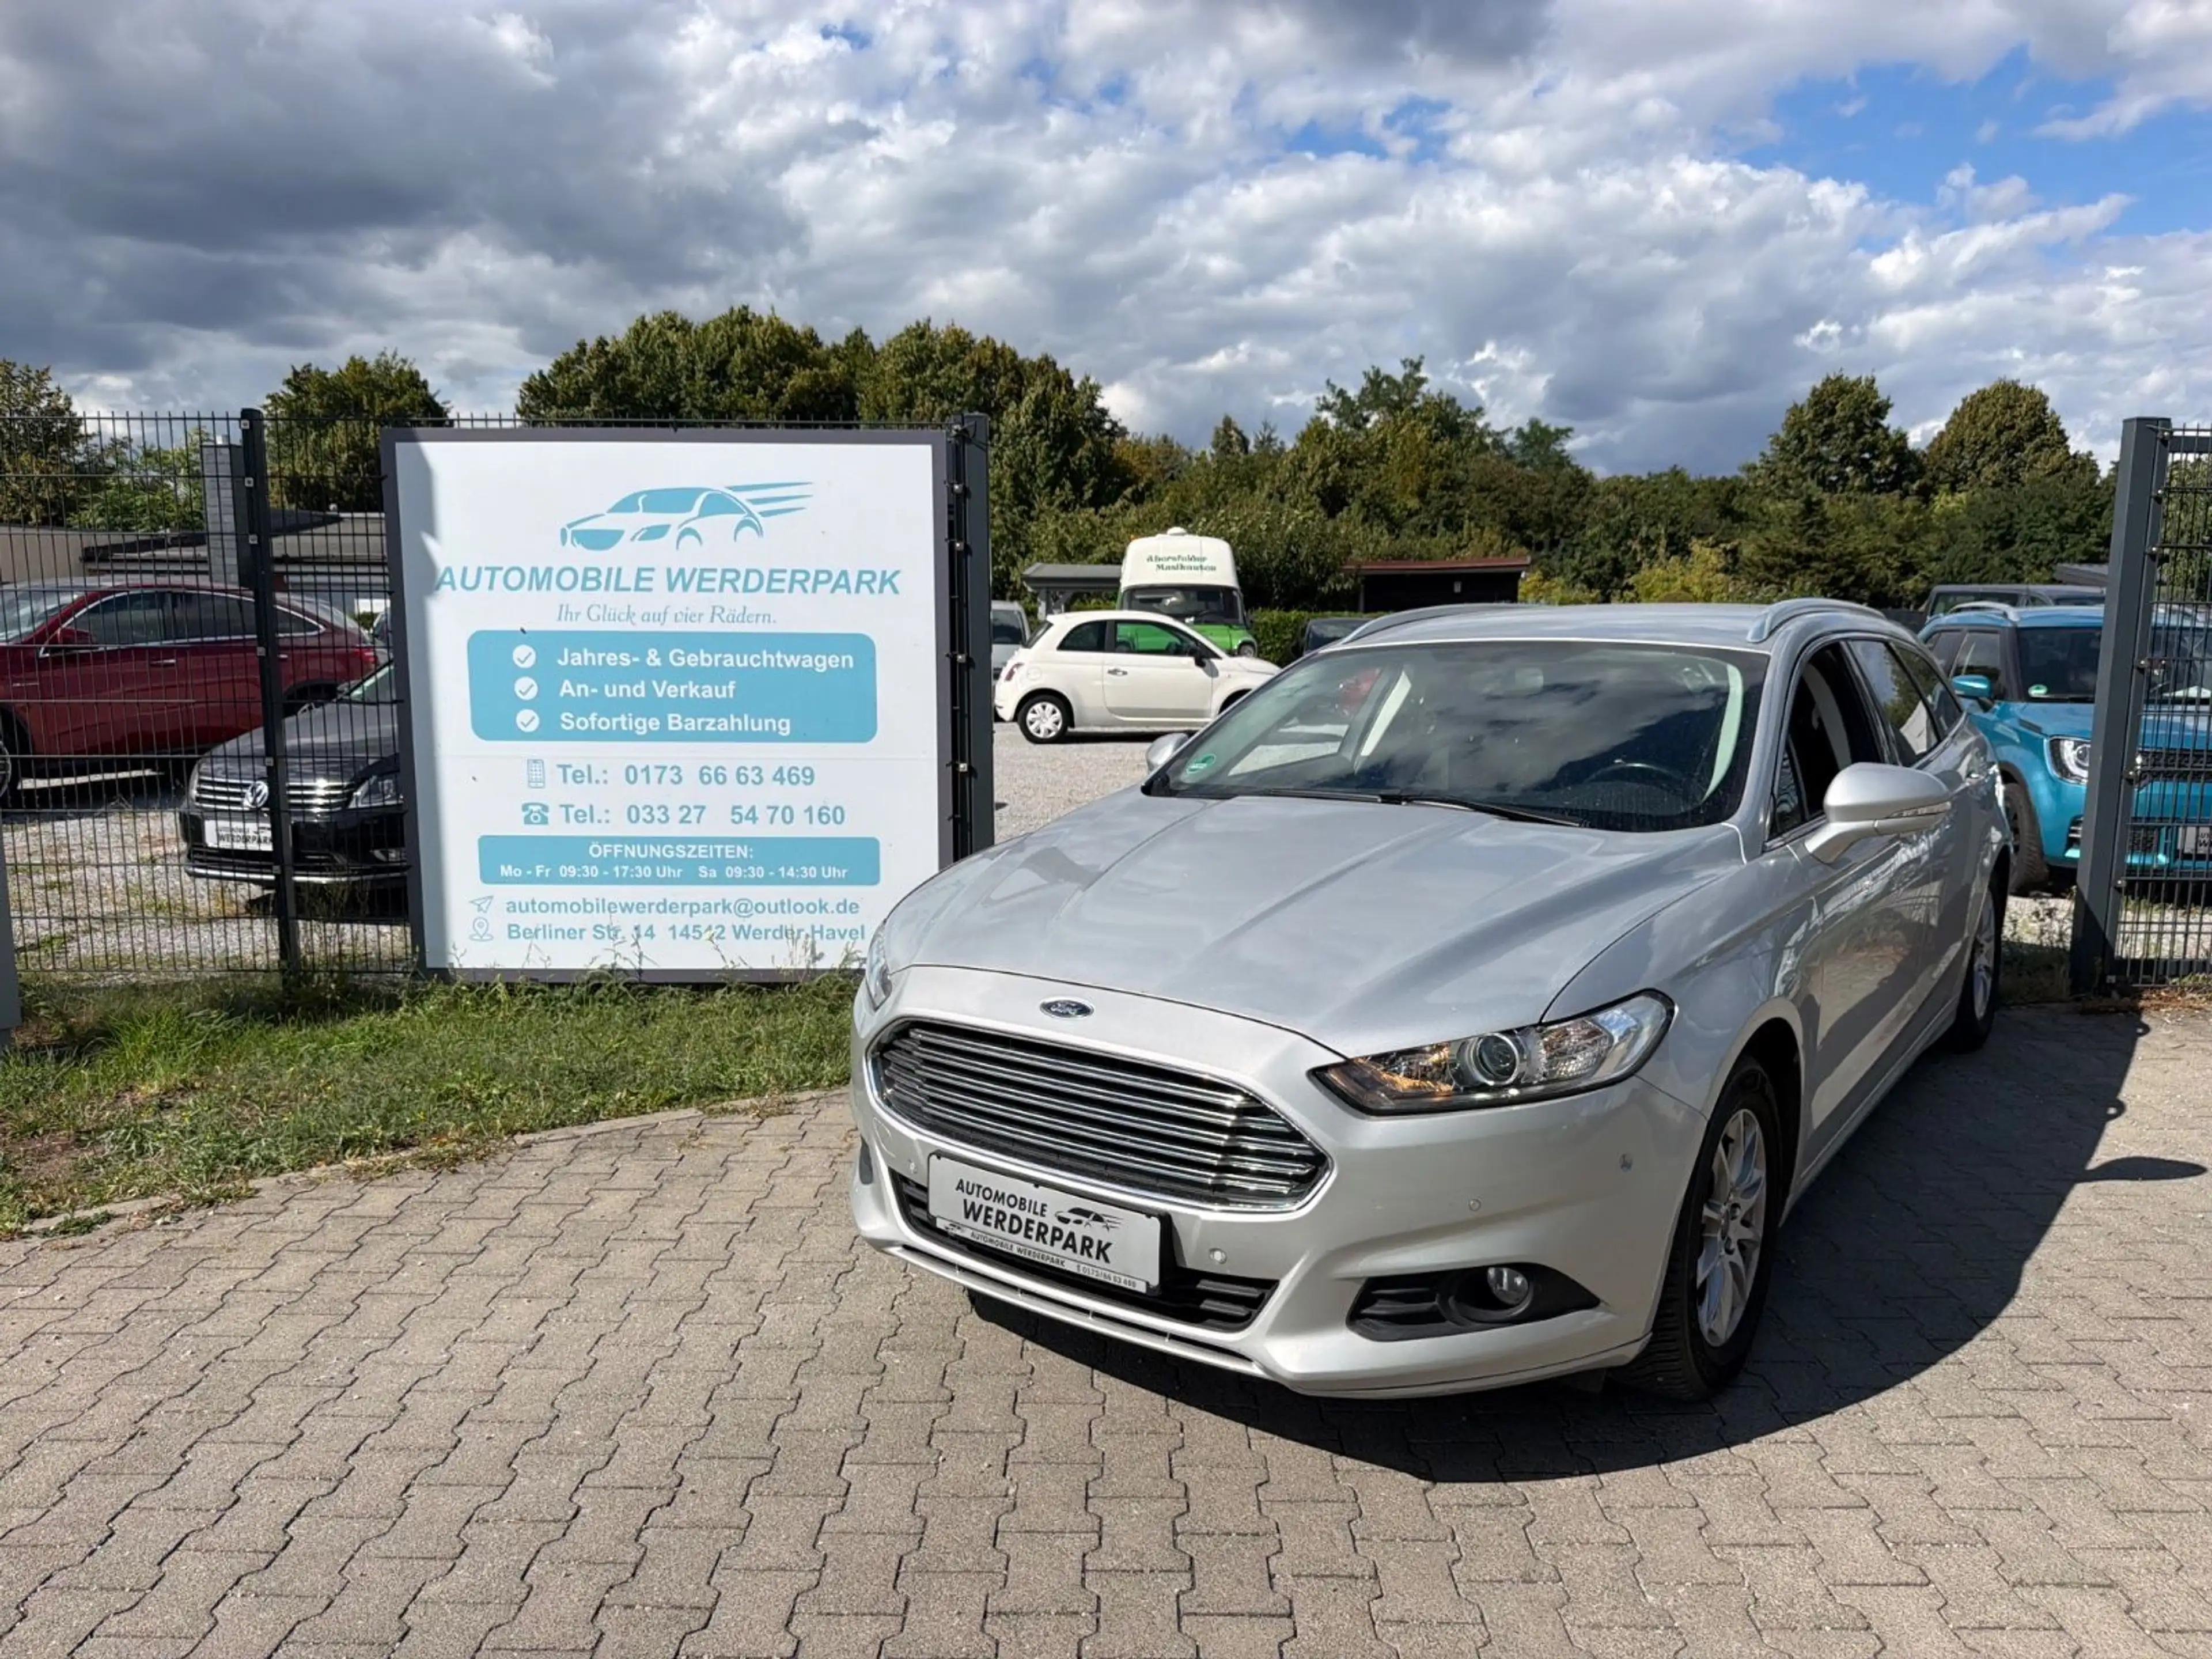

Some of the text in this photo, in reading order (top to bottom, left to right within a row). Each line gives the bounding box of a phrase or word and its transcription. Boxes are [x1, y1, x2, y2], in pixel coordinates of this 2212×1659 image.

[435, 566, 901, 595] AUTOMOBILE WERDERPARK
[556, 603, 777, 626] Ihr Glück auf vier Rädern.
[557, 647, 854, 672] Jahres- & Gebrauchtwagen
[559, 679, 736, 699] An- und Verkauf
[560, 712, 791, 736] Sofortige Barzahlung
[556, 764, 815, 786] Tel.: 0173 66 63 469
[559, 804, 845, 825] Tel.: 033 27 54 70 160
[589, 842, 753, 858] ÖFFNUNGSZEITEN:
[500, 865, 522, 877] Mo
[535, 865, 551, 877] Fr
[559, 865, 599, 877] 09:30
[613, 865, 652, 878] 17:30
[656, 866, 683, 878] Uhr
[698, 865, 717, 878] Sa
[725, 866, 764, 878] 09:30
[778, 866, 817, 878] 14:30
[821, 866, 847, 878] Uhr
[506, 897, 860, 919] automobilewerderpark@outlook.de
[507, 923, 586, 940] Berliner
[593, 923, 626, 940] Str.
[633, 924, 656, 940] 14
[732, 924, 805, 940] Werder
[811, 924, 865, 940] Havel
[955, 1178, 1048, 1218] AUTOMOBILE
[963, 1199, 1113, 1264] WERDERPARK
[970, 1232, 1013, 1251] AUTOMOBILE
[1016, 1246, 1066, 1267] WERDERPARK
